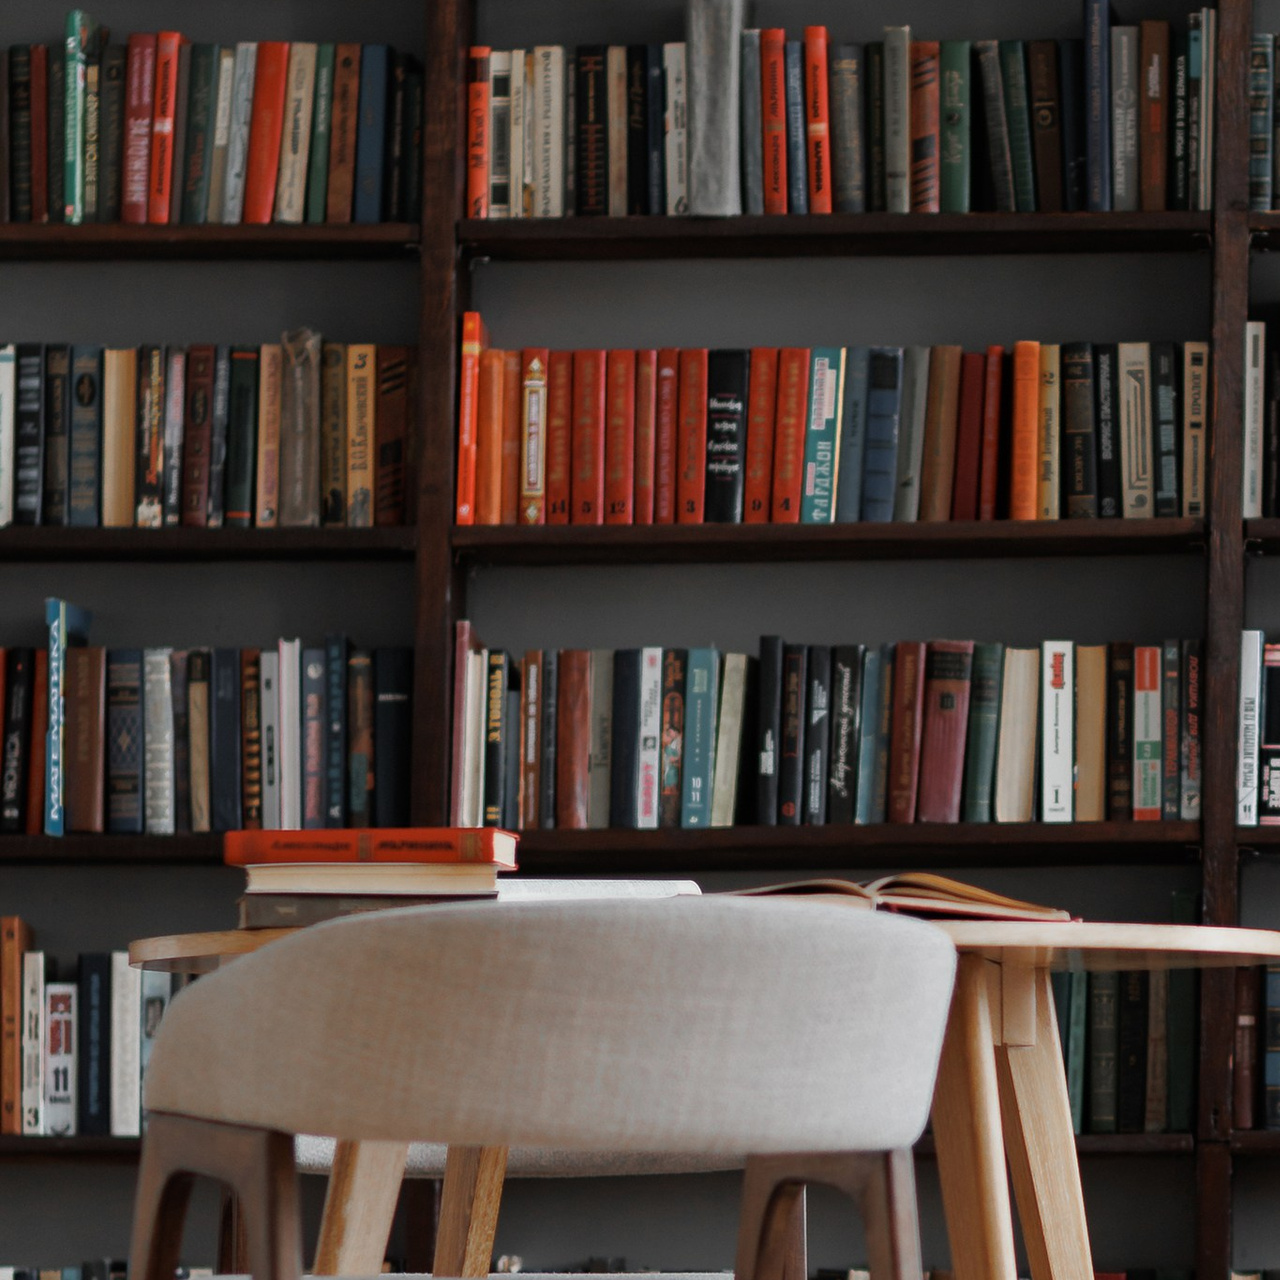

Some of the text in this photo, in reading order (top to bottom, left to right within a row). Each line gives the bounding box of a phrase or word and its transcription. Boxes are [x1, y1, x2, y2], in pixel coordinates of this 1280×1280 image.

[1100, 353, 1112, 460] БОРИС ПАСТЕРНАК
[1191, 371, 1201, 416] ПРОЛОГ
[50, 618, 59, 821] МАТЕМАТИКА
[1188, 655, 1198, 735] ЛОВУШКА ДЛЯ
[692, 776, 702, 789] 10
[692, 791, 701, 802] 11
[831, 717, 852, 798] Американский
